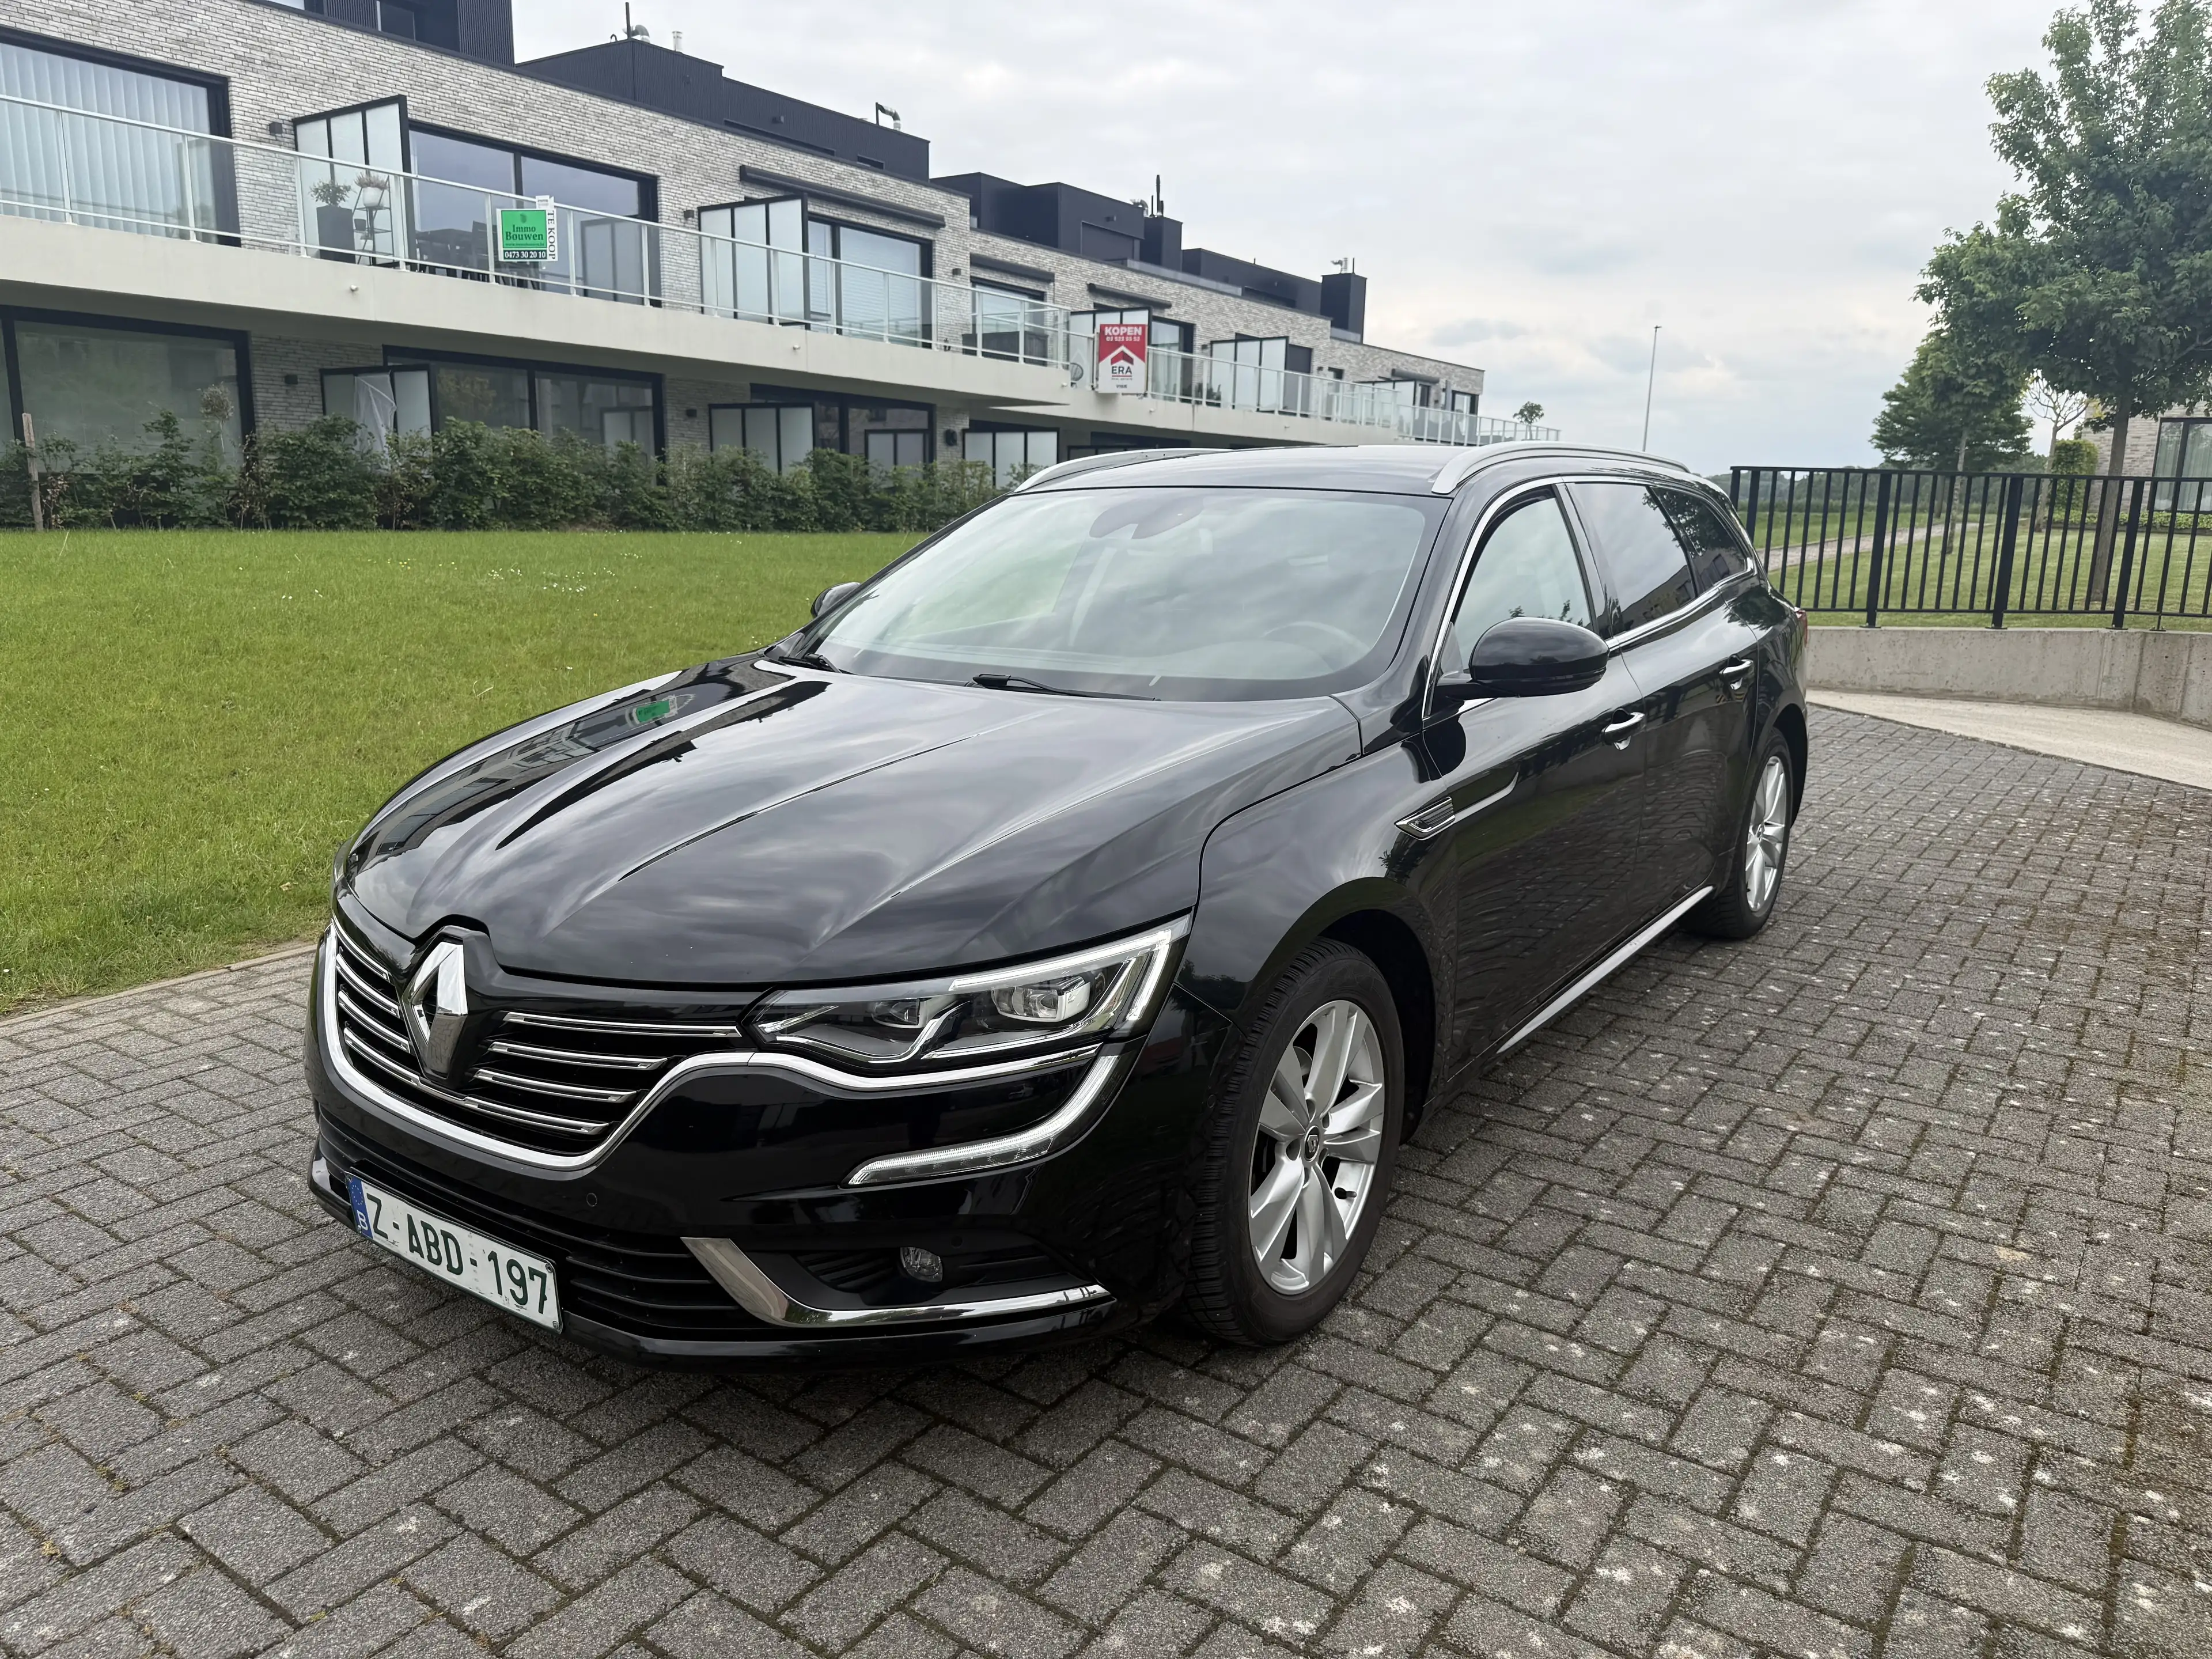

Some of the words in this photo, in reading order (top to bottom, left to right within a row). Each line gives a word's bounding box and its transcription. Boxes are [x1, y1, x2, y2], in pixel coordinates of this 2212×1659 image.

[548, 210, 554, 225] TE
[506, 232, 543, 240] Bouwen
[1105, 327, 1142, 335] KOPEN
[1112, 366, 1132, 374] ERA
[357, 1210, 368, 1231] B
[366, 1192, 547, 1315] Z-ABD-197
